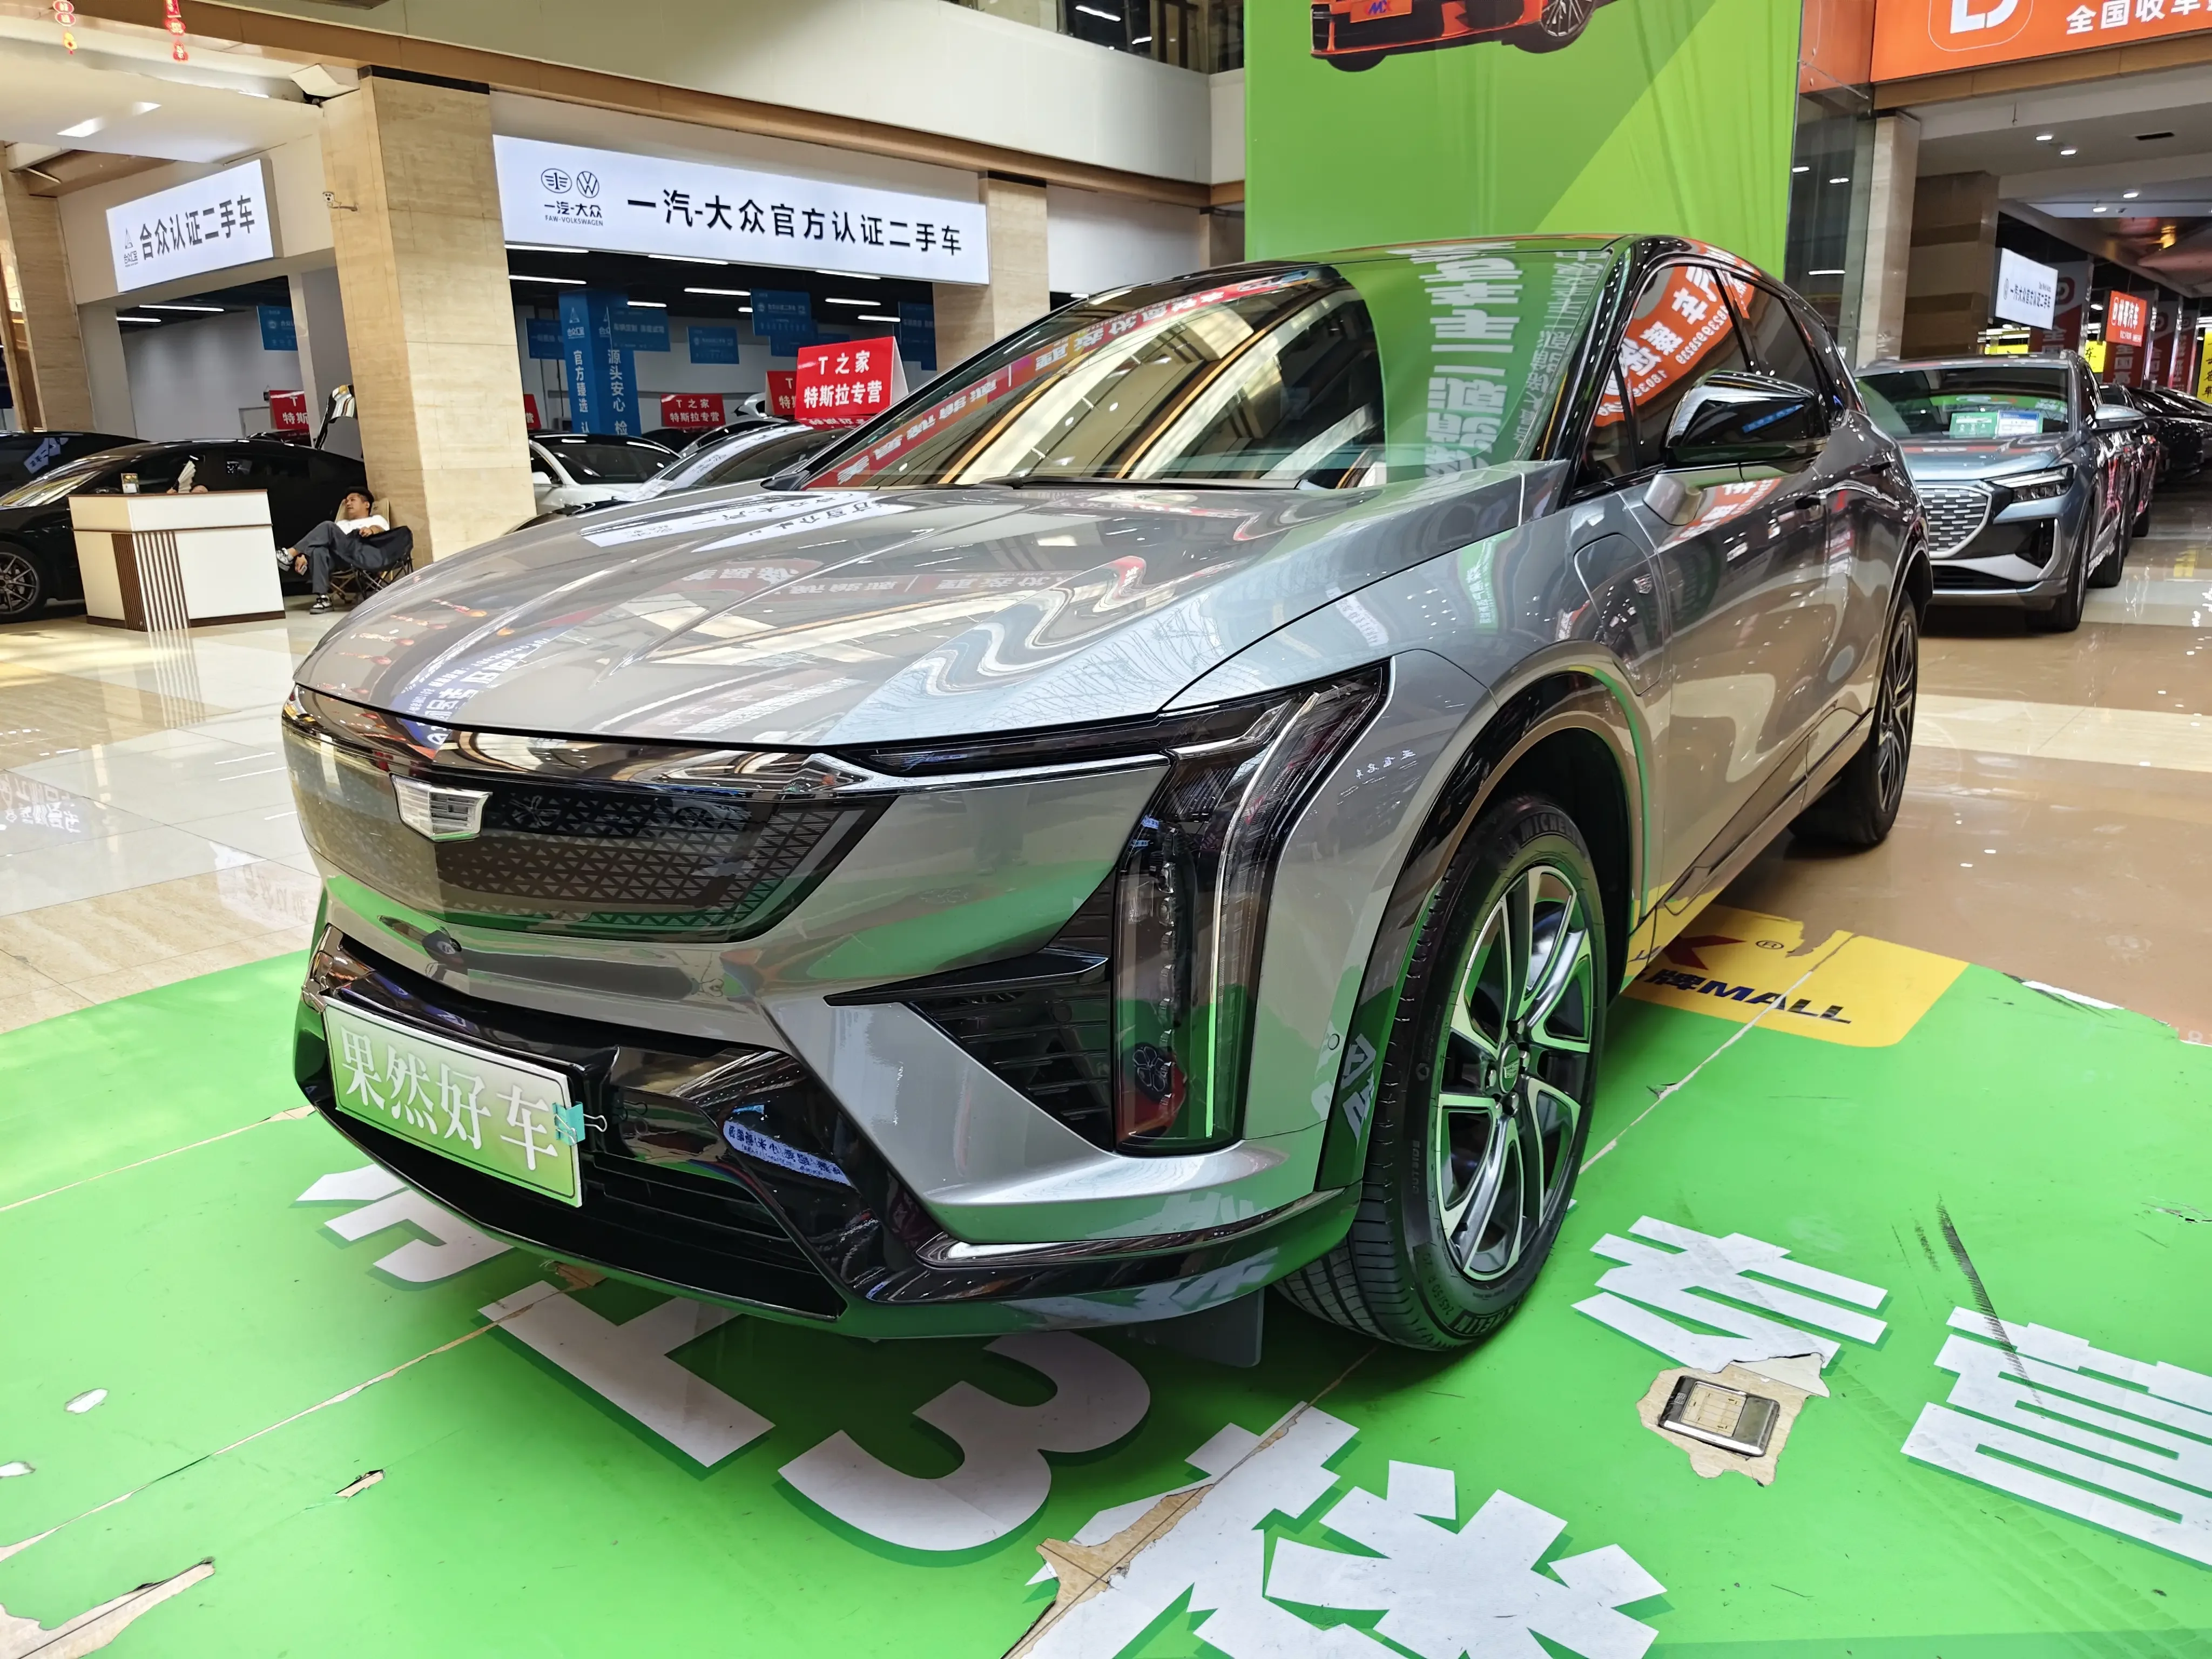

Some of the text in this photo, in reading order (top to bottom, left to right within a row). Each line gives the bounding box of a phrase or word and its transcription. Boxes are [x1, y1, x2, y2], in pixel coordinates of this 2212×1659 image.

[139, 195, 255, 260] 合众认证二手车
[544, 201, 603, 219] 一汽-大众
[545, 214, 604, 227] FAW-VOLKSWAGEN
[628, 189, 962, 256] 一汽-大众官方认证二手车
[608, 349, 625, 413] 源头安心
[804, 380, 882, 408] 特斯拉专营
[670, 411, 720, 423] 特斯拉专营
[1635, 965, 1852, 1024] 牌MALL
[340, 1025, 558, 1171] 果然好车
